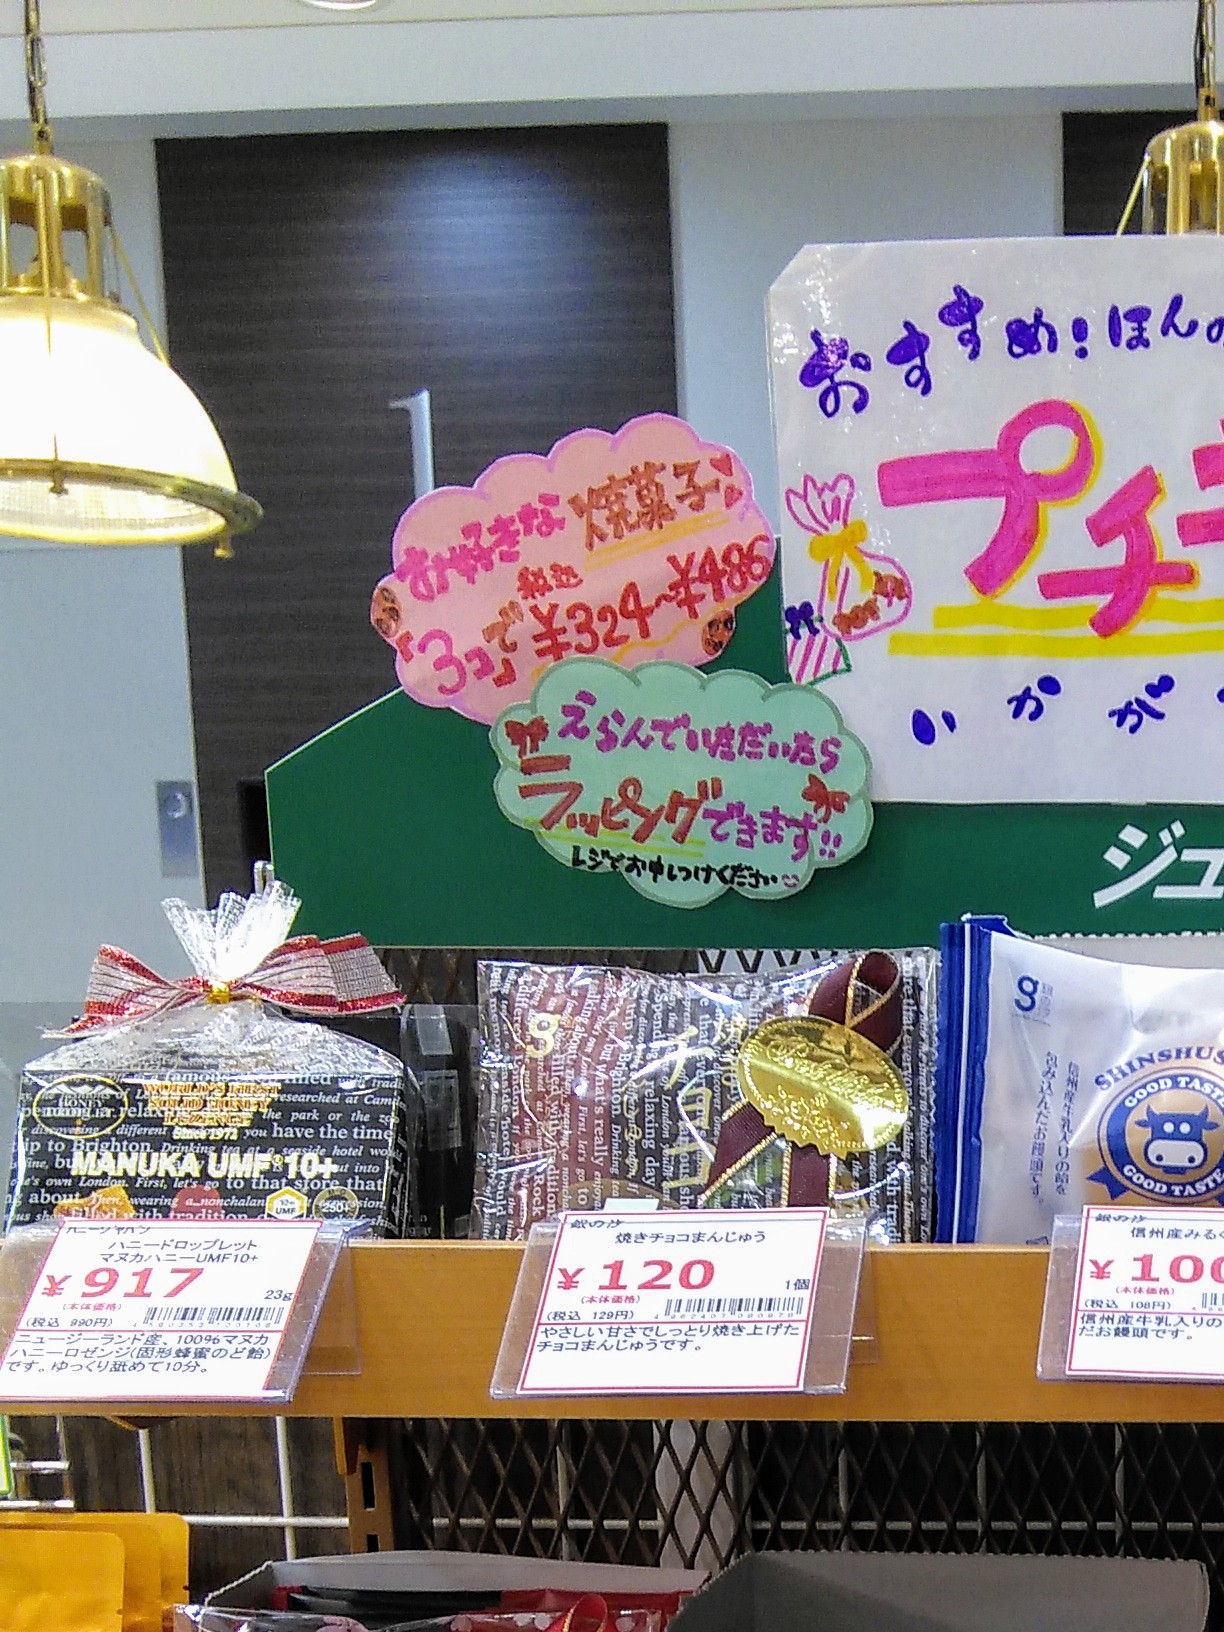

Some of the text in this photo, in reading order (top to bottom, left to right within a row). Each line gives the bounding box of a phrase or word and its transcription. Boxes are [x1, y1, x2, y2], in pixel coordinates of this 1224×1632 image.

[1124, 1077, 1172, 1108] GOOD
[71, 1152, 201, 1177] MANUKA
[1124, 1164, 1168, 1194] GOOD
[615, 1231, 766, 1243] 焼きチョコまんじゅう
[108, 1240, 258, 1250] ハニードロップレット
[785, 1279, 810, 1291] 1個
[264, 1290, 294, 1301] 23g
[541, 1324, 799, 1338] やさしい甘さでしっとり焼き上げた
[537, 1339, 702, 1352] チョコまんじゅうです。
